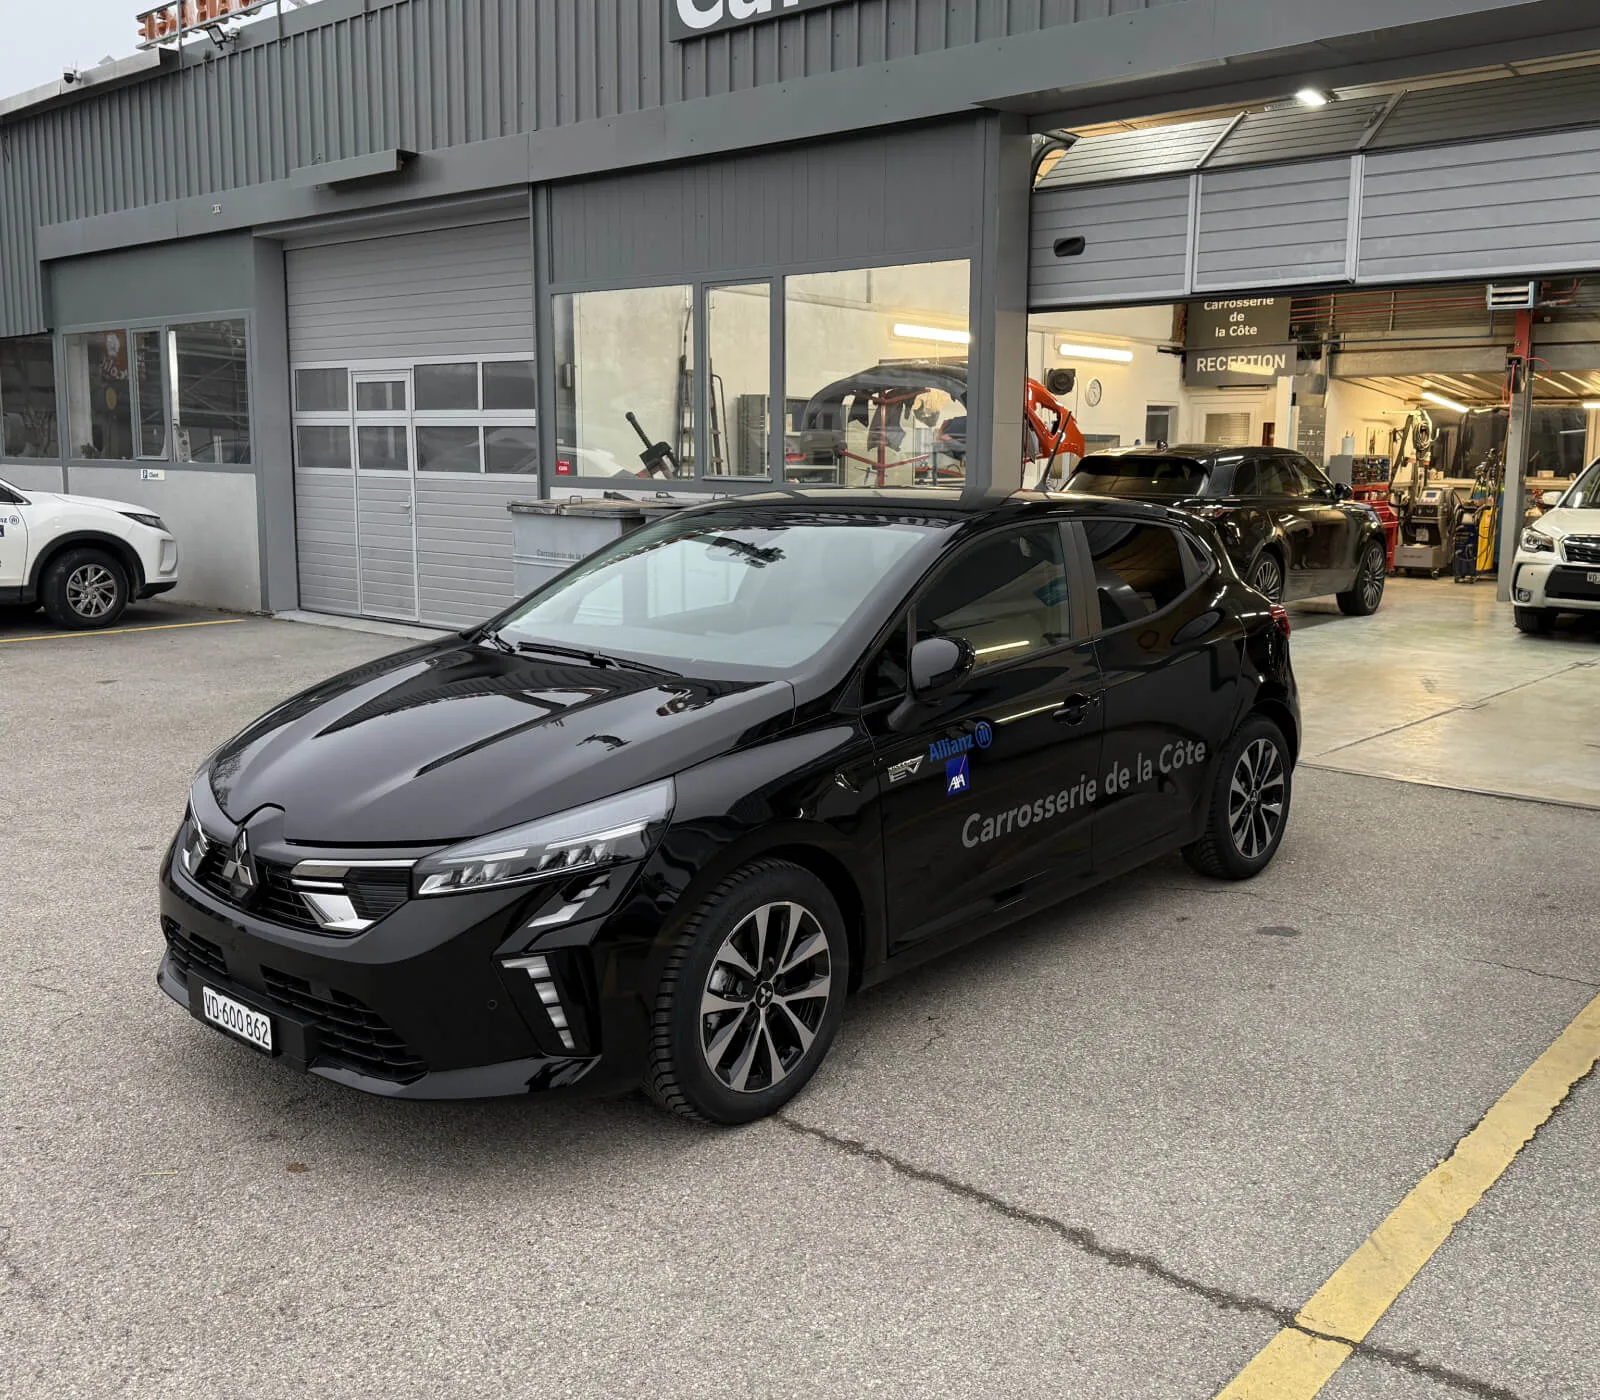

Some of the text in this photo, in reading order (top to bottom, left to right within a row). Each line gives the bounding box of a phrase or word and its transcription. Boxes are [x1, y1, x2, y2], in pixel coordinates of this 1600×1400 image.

[1229, 312, 1245, 322] de
[1215, 325, 1258, 337] la Côte
[1196, 354, 1286, 372] RECEPTION
[929, 734, 975, 762] Allianz
[948, 774, 966, 792] AXA
[962, 740, 1206, 848] Carrosserie de la Côte
